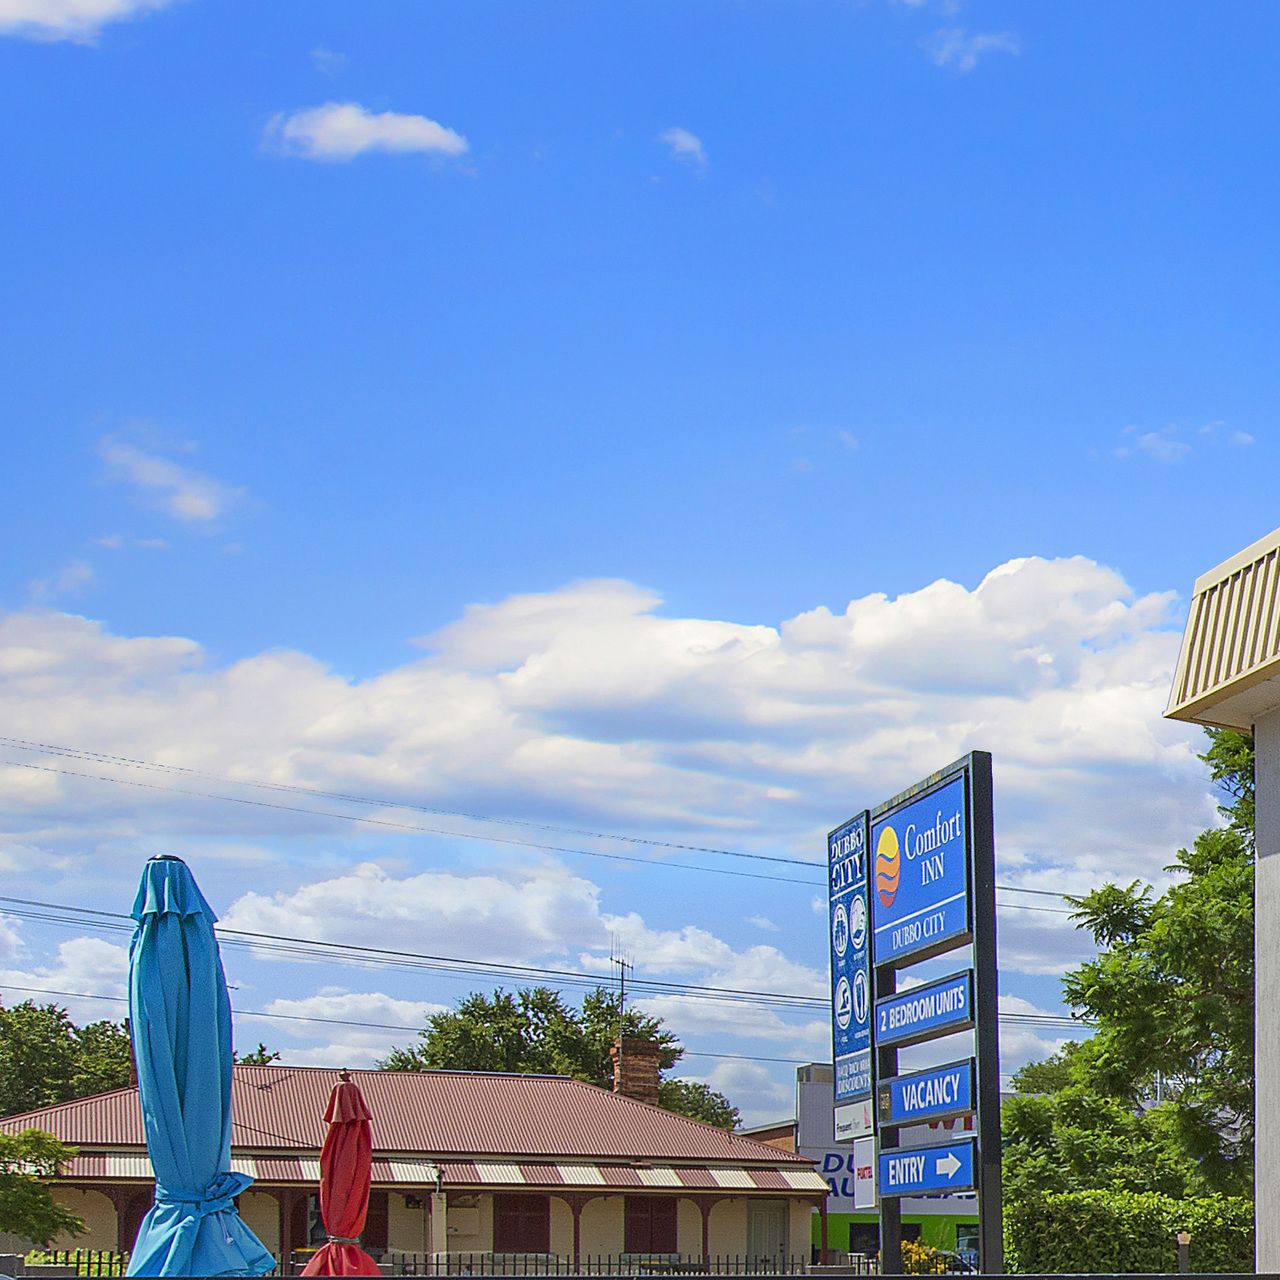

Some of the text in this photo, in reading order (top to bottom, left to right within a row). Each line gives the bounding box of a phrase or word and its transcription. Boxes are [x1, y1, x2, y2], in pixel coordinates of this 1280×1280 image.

[831, 828, 863, 862] DUBBO
[905, 810, 961, 860] Comfort
[832, 850, 864, 890] CITY
[921, 852, 944, 886] INN
[892, 911, 946, 950] DUBBO CITY
[881, 985, 965, 1031] 2 BEDROOM UNITS
[902, 1073, 960, 1111] VACANCY
[888, 1156, 925, 1185] ENTRY
